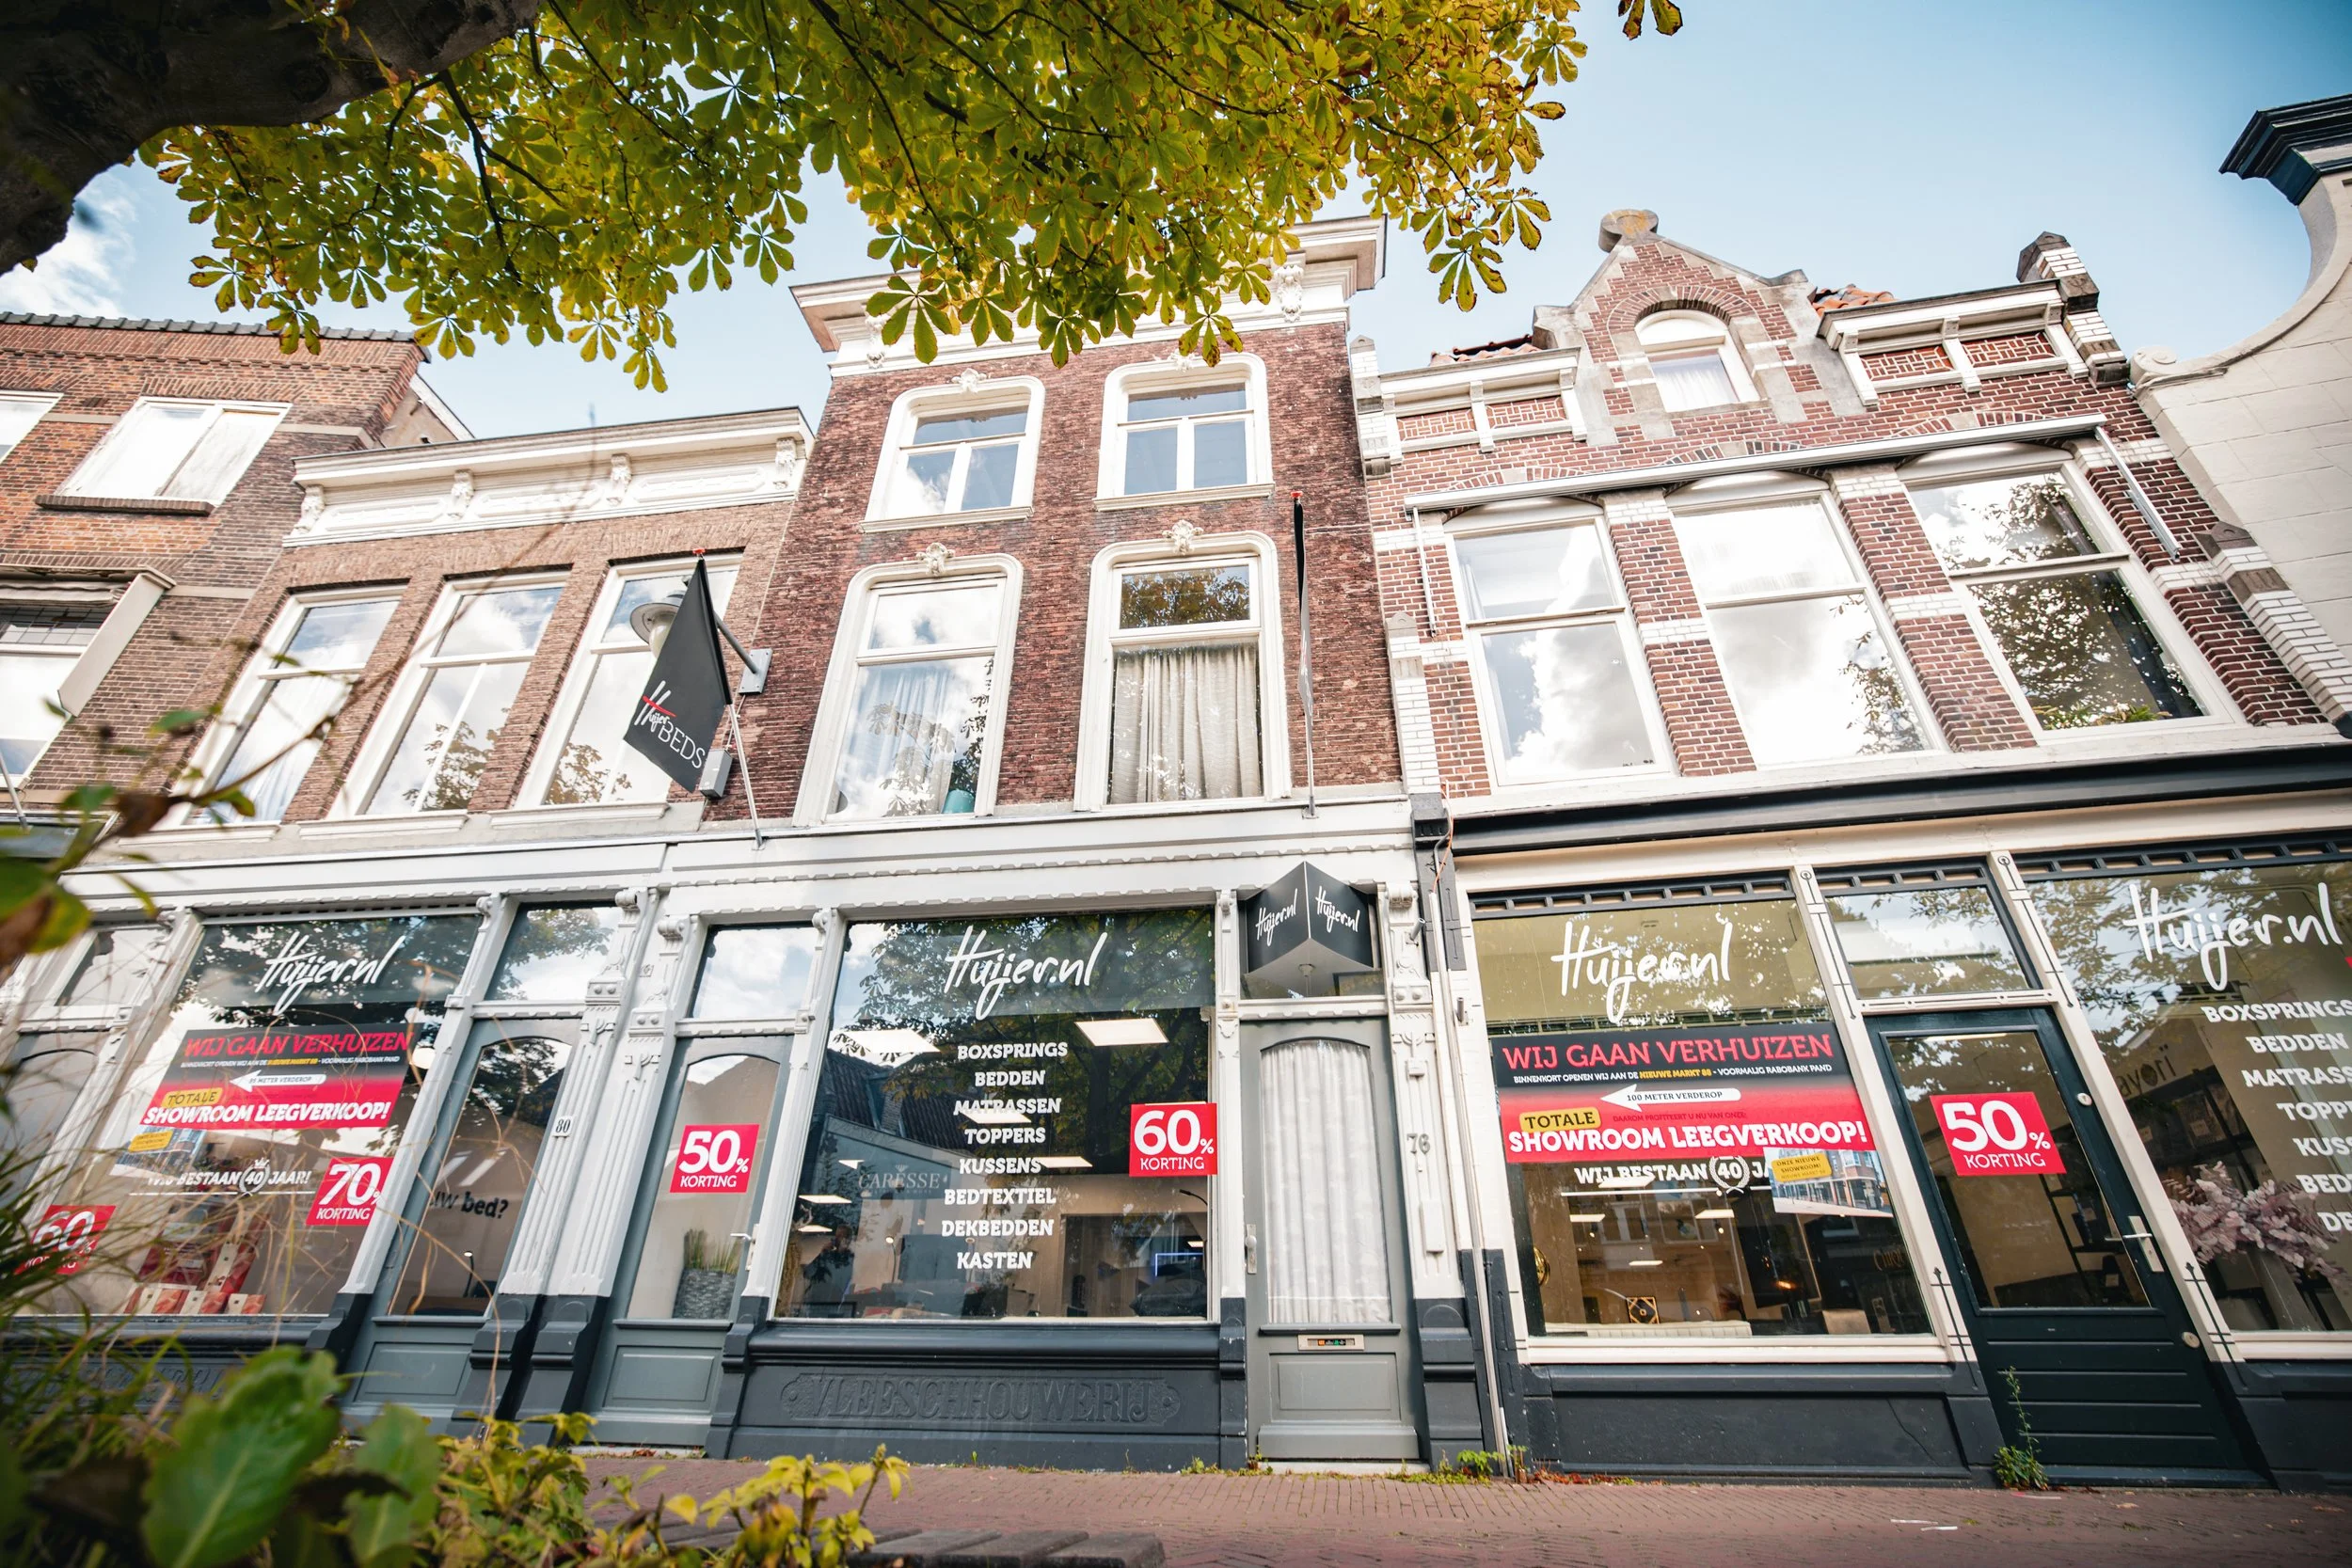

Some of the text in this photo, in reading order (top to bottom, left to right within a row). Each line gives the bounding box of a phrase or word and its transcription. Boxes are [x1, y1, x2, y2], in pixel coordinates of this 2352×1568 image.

[658, 721, 706, 768] BEDS
[1255, 888, 1298, 947] Huijer.nl
[1314, 885, 1360, 933] Huijer.nl
[2122, 881, 2344, 991] Huijer.nl
[254, 930, 406, 1016] Huijer.nl
[944, 925, 1108, 1021] Huijer.nl
[1550, 920, 1734, 1023] Huijer.nl
[2201, 999, 2352, 1023] BOXSPRINGS
[184, 1031, 415, 1057] WIJ GAAN VERHUIZEN
[957, 1042, 1069, 1060] BOXSPRINGS
[1502, 1034, 1834, 1069] WIJ GAAN VERHUIZEN
[2245, 1032, 2349, 1053] BEDDEN
[975, 1070, 1046, 1086] BEDDEN
[1514, 1074, 1562, 1084] BINNENKORT
[1563, 1072, 1594, 1082] OPENEN
[1594, 1072, 1610, 1081] WIJ
[1610, 1071, 1627, 1080] AAN
[1628, 1071, 1639, 1080] DE
[1639, 1069, 1672, 1079] NIEUWE
[1672, 1069, 1700, 1078] MARKT
[1717, 1066, 1766, 1076] VOORMALIG
[1766, 1065, 1808, 1074] RABOBANK
[1809, 1064, 1833, 1072] PAND
[167, 1090, 218, 1105] TOTALE
[1645, 1092, 1675, 1101] METER
[1676, 1091, 1723, 1100] VERDEROP
[143, 1101, 391, 1124] SHOWROOM LEEGVERKOOP!
[953, 1098, 1061, 1116] MATRASSEN
[555, 1118, 571, 1133] 80
[1525, 1112, 1596, 1129] TOTALE
[1942, 1100, 2051, 1152] 50%
[964, 1127, 1046, 1145] TOPPERS
[1134, 1109, 1215, 1156] 60%
[1508, 1120, 1867, 1153] SHOWROOM LEEGVERKOOP!
[678, 1129, 749, 1175] 50%
[1406, 1133, 1431, 1155] 76
[959, 1157, 1042, 1175] KUSSENS
[1140, 1157, 1205, 1171] KORTING
[1963, 1152, 2047, 1169] KORTING
[177, 1171, 243, 1186] BESTAAN
[245, 1171, 262, 1185] 40
[268, 1170, 312, 1185] JAAR!
[679, 1175, 737, 1188] KORTING
[1574, 1165, 1614, 1184] WIJ
[1617, 1162, 1709, 1182] BESTAAN
[1717, 1162, 1742, 1180] 40
[461, 1191, 509, 1219] bed?
[944, 1187, 1057, 1205] BEDTEXTIEL
[316, 1207, 372, 1221] KORTING
[941, 1219, 1054, 1237] DEKBEDDEN
[957, 1251, 1033, 1270] KASTEN
[813, 1376, 1152, 1423] VLEESCHHOUWERIJ
